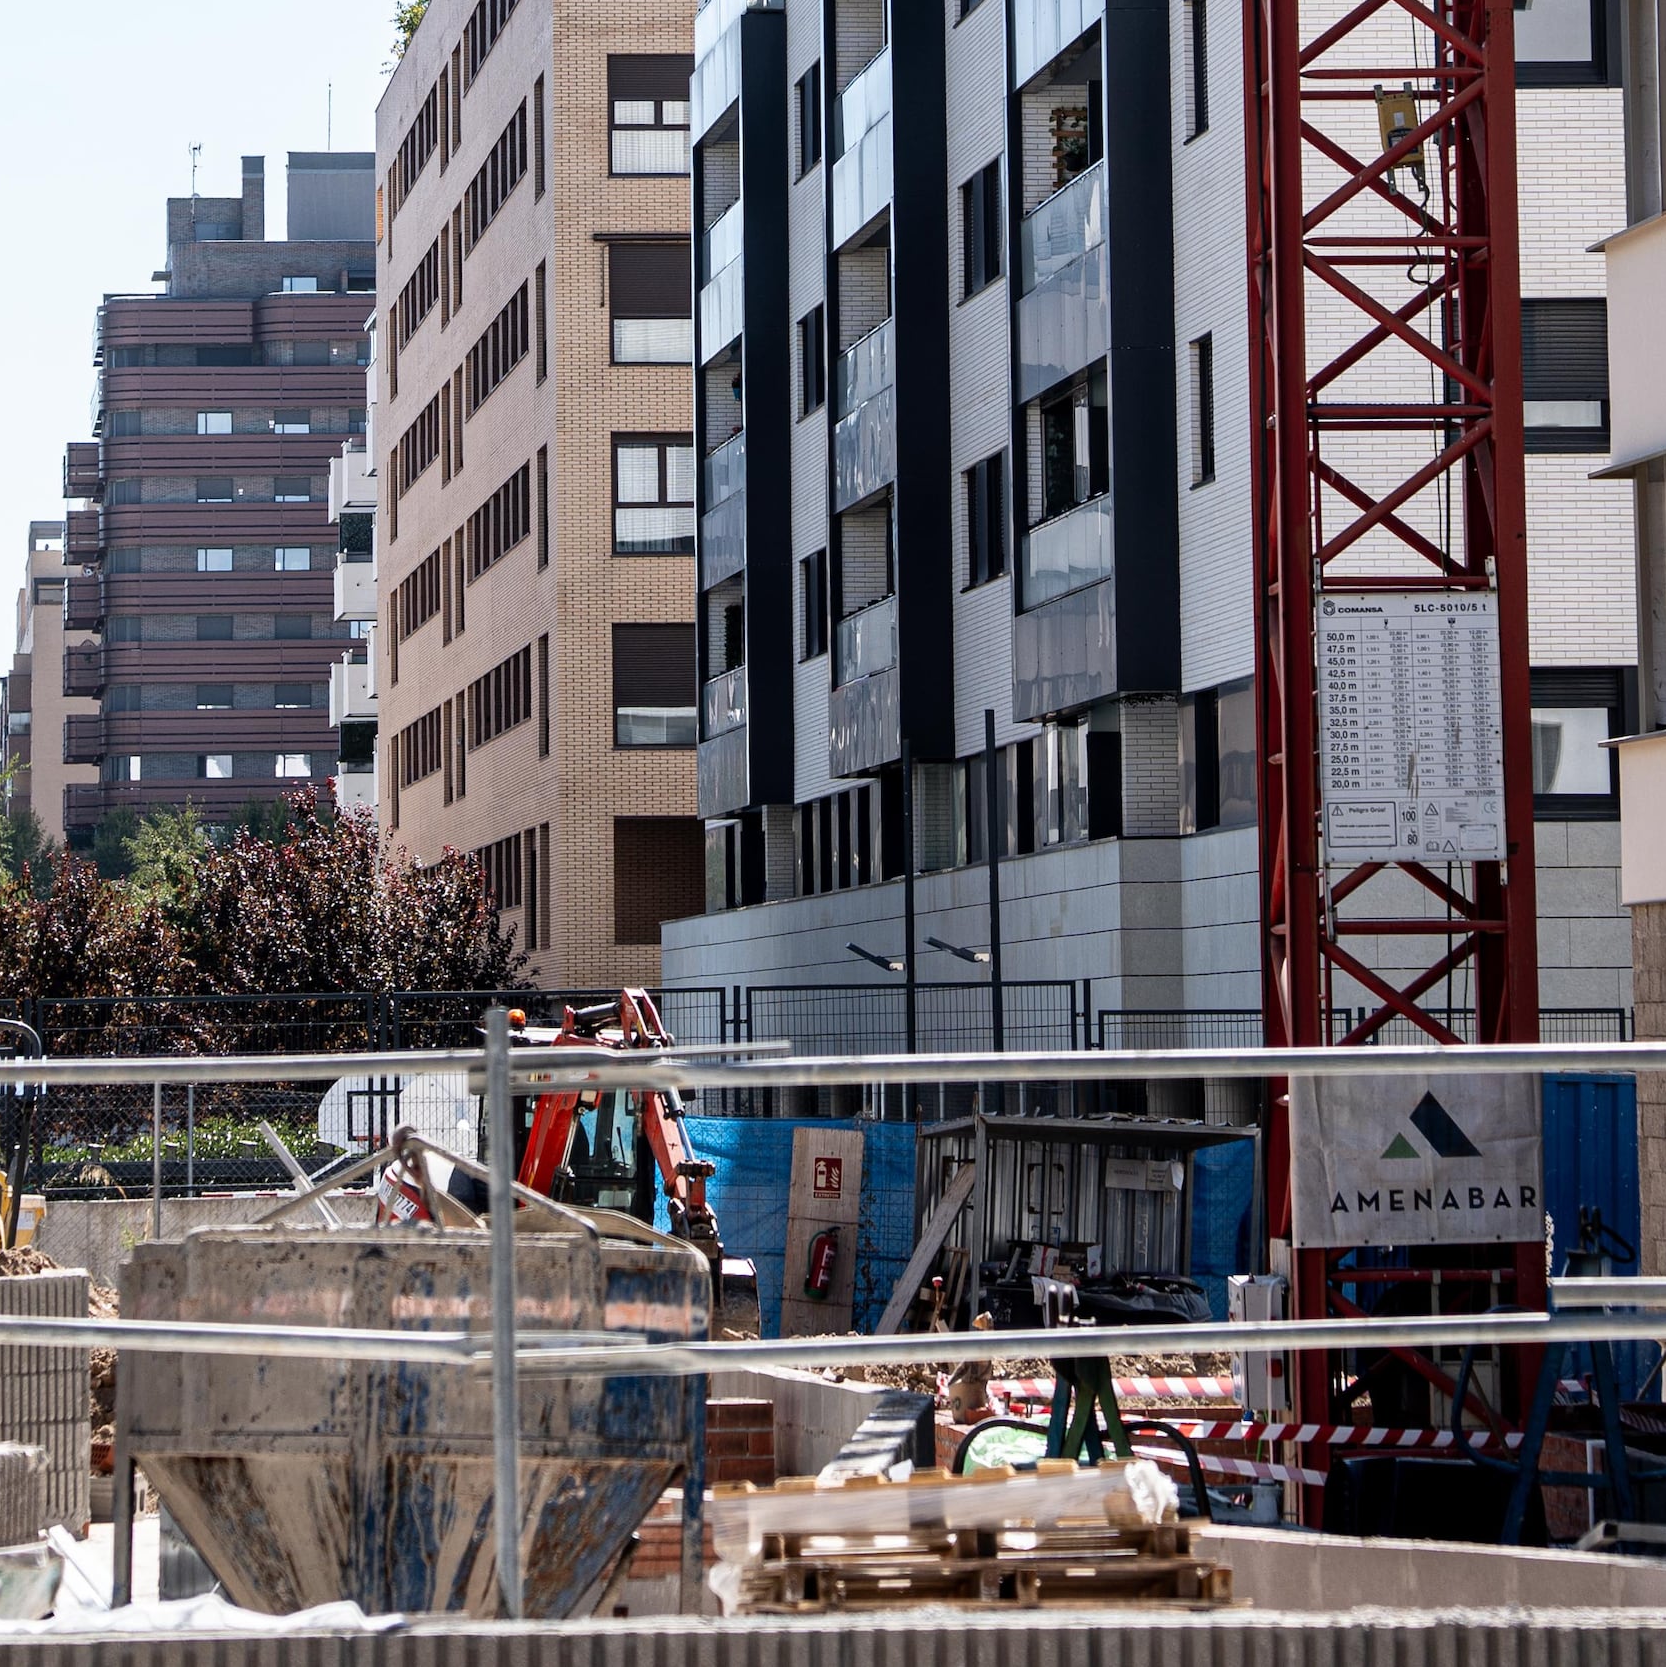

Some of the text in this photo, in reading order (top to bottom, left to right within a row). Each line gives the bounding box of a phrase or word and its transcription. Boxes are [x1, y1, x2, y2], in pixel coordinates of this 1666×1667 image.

[1337, 606, 1383, 614] COMANSA
[1414, 603, 1487, 613] 5LC-5010/5 t
[1326, 632, 1345, 642] 50,0
[1327, 645, 1345, 655] 47,5
[1327, 657, 1346, 667] 45,0
[1327, 669, 1346, 679] 42,5
[1328, 681, 1347, 691] 40,0
[1328, 694, 1347, 704] 37,5
[1329, 706, 1348, 716] 35,0
[1329, 718, 1348, 728] 32,5
[1330, 731, 1348, 740] 30,0
[1330, 743, 1349, 753] 27,5
[1330, 755, 1349, 765] 25,0
[1331, 767, 1350, 777] 22,5
[1331, 780, 1350, 789] 20,0
[1401, 810, 1416, 822] 100
[1331, 1185, 1538, 1214] AMENABAR
